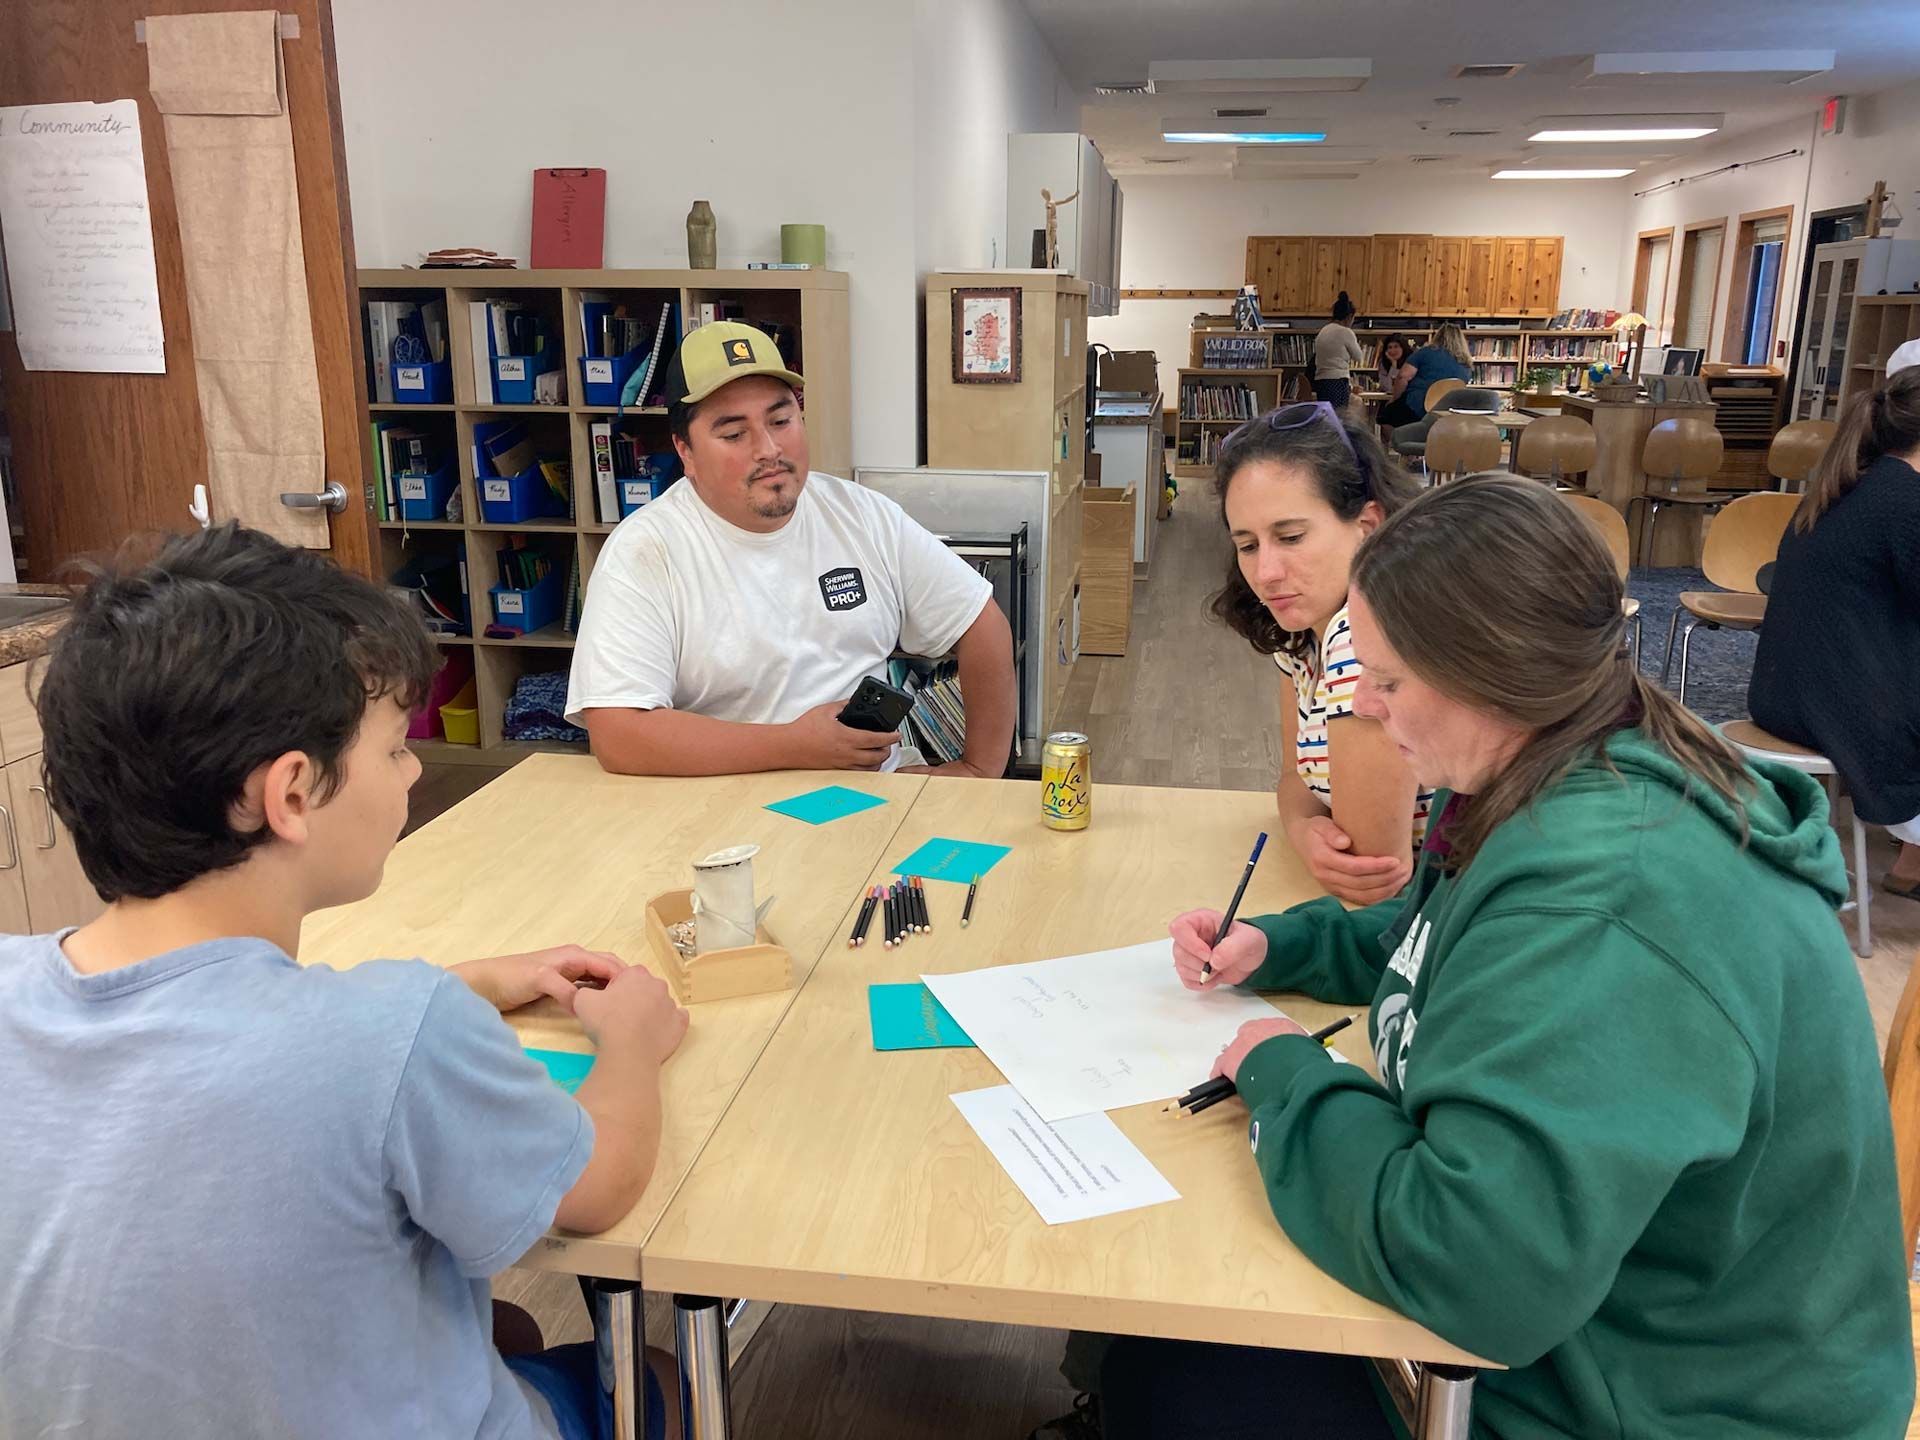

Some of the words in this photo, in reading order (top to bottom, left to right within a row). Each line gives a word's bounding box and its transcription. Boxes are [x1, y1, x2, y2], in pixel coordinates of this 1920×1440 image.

[20, 109, 131, 135] Community
[824, 572, 855, 586] SHERWIN
[825, 579, 858, 594] WILLIAMS
[828, 591, 862, 608] PRO+
[1059, 762, 1081, 792] La
[1042, 781, 1089, 813] Croix
